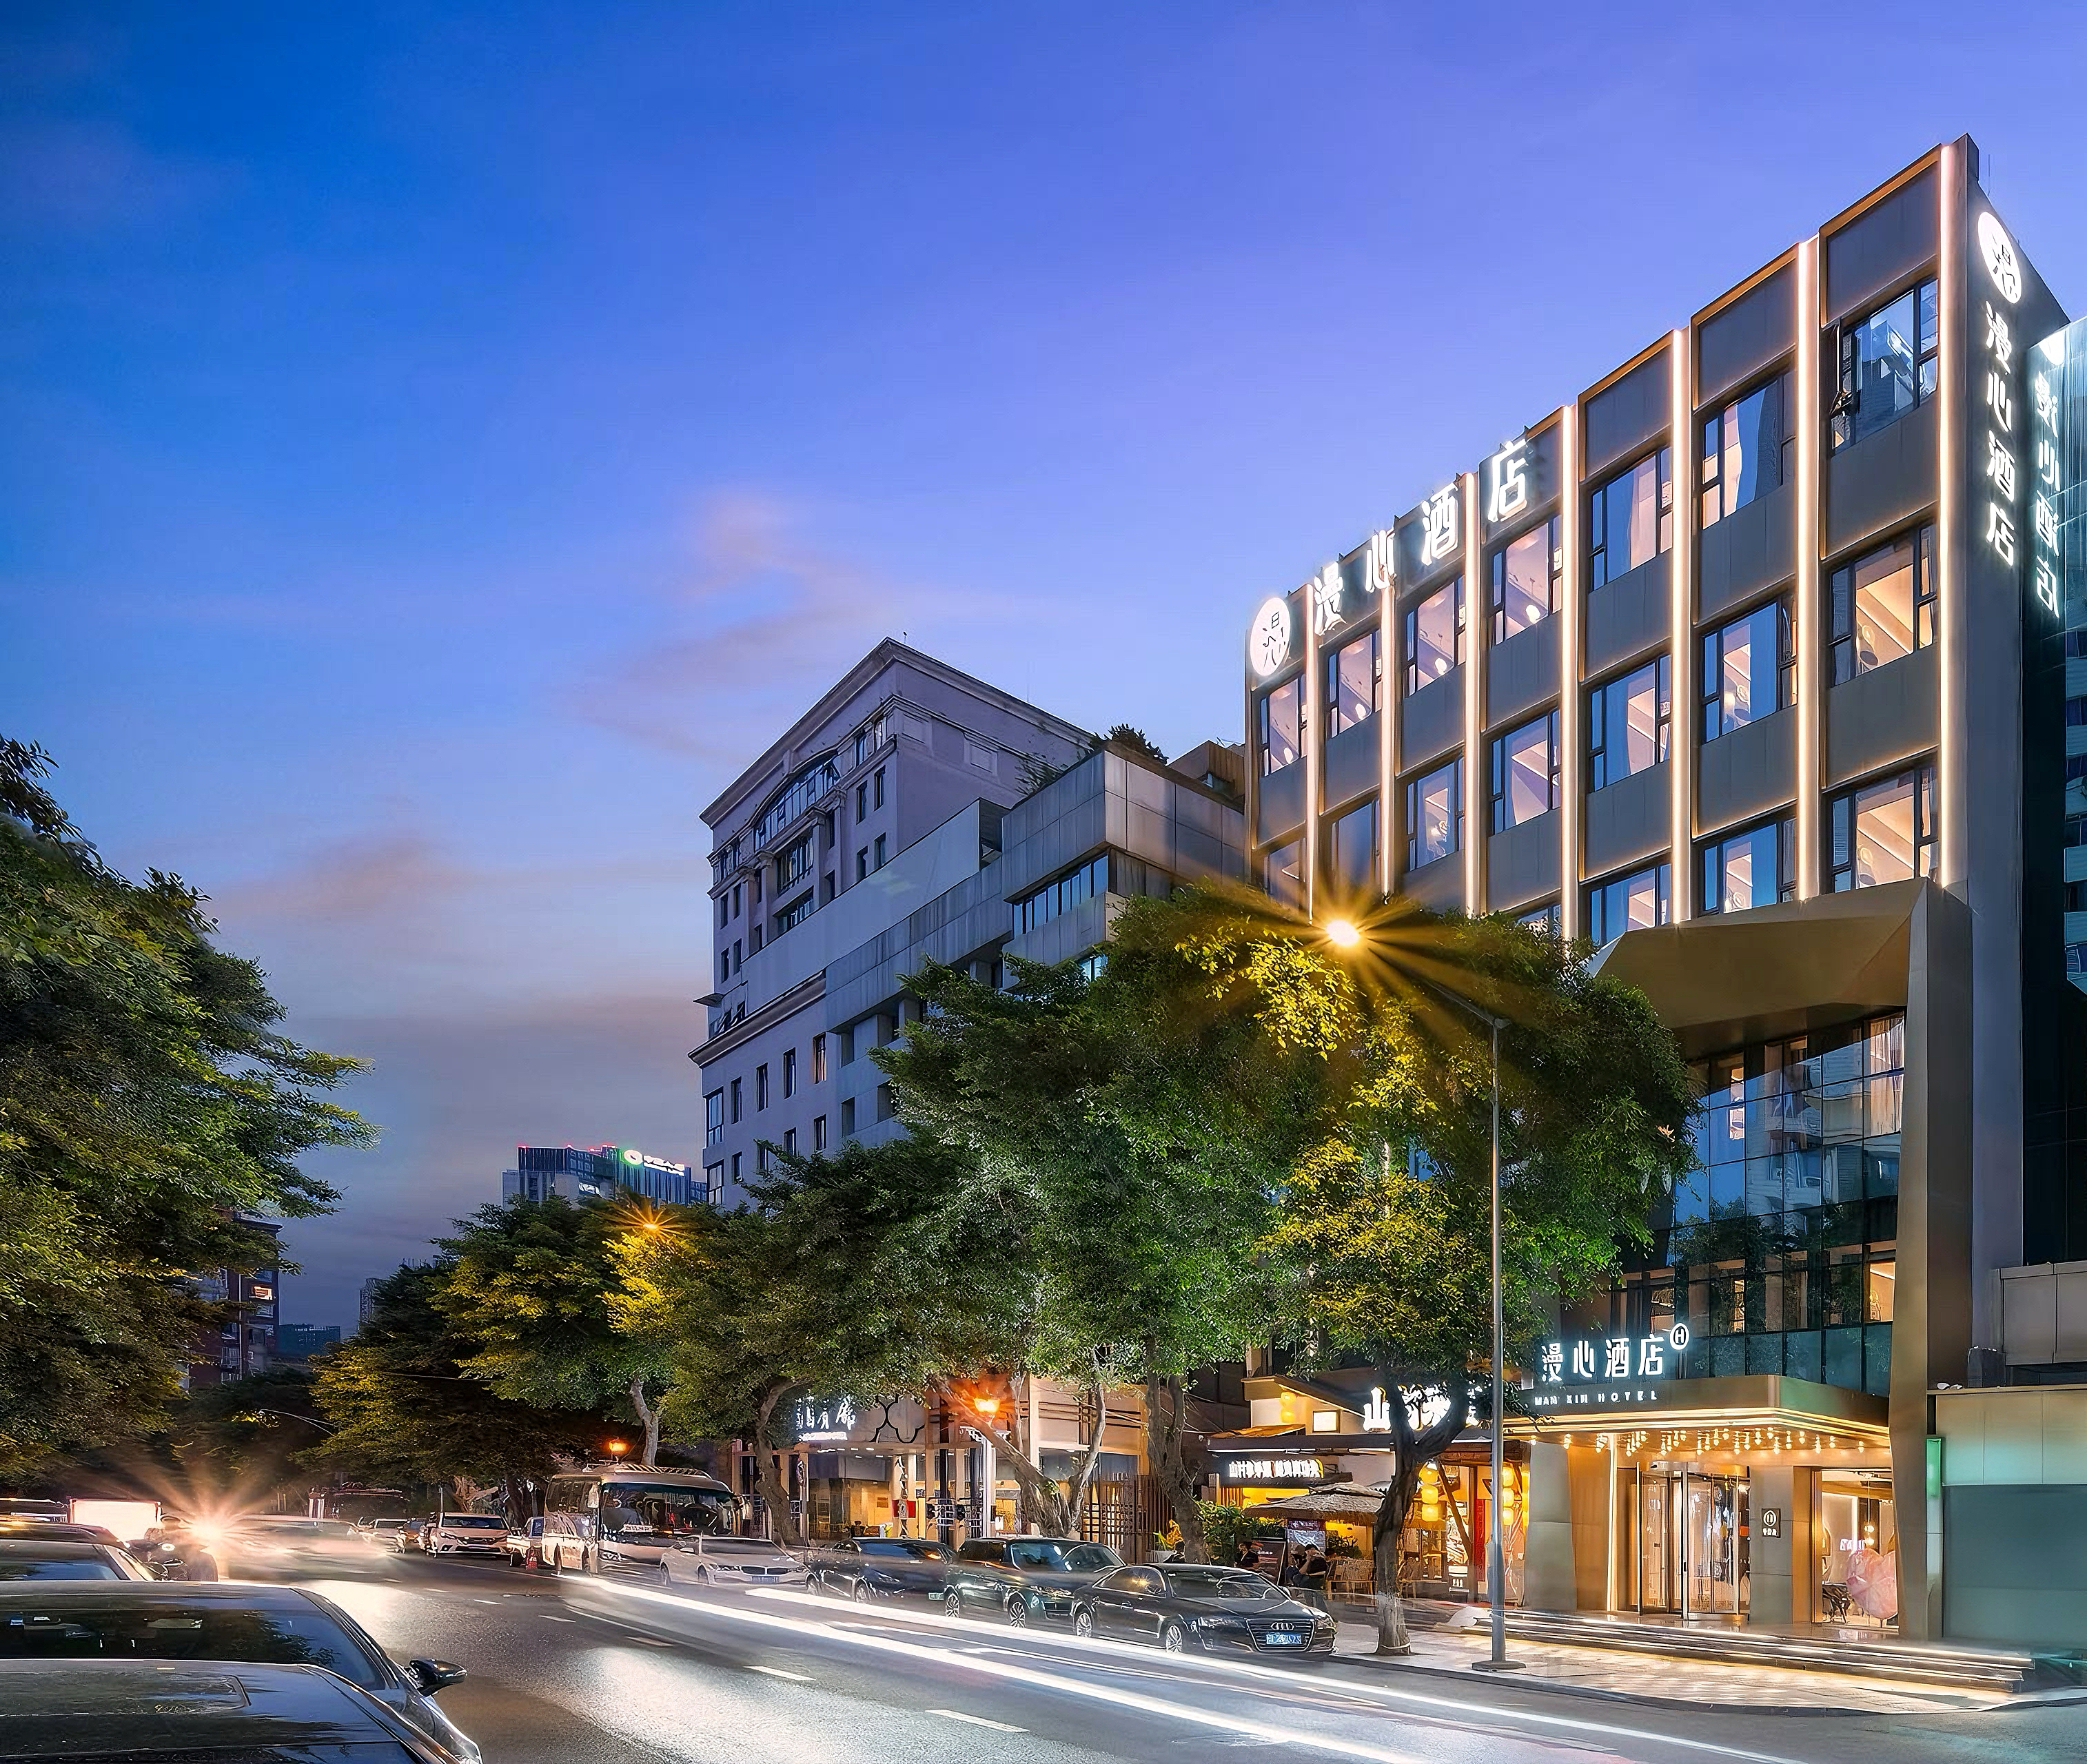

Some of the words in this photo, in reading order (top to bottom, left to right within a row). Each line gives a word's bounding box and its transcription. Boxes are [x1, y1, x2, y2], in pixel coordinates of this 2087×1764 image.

[1985, 300, 2015, 567] 漫心酒店
[1313, 439, 1529, 637] 漫心酒店
[1534, 1395, 1558, 1406] MAN
[1566, 1393, 1589, 1404] XIN
[1598, 1390, 1658, 1404] HOTEL
[1540, 1333, 1664, 1383] 漫心酒店
